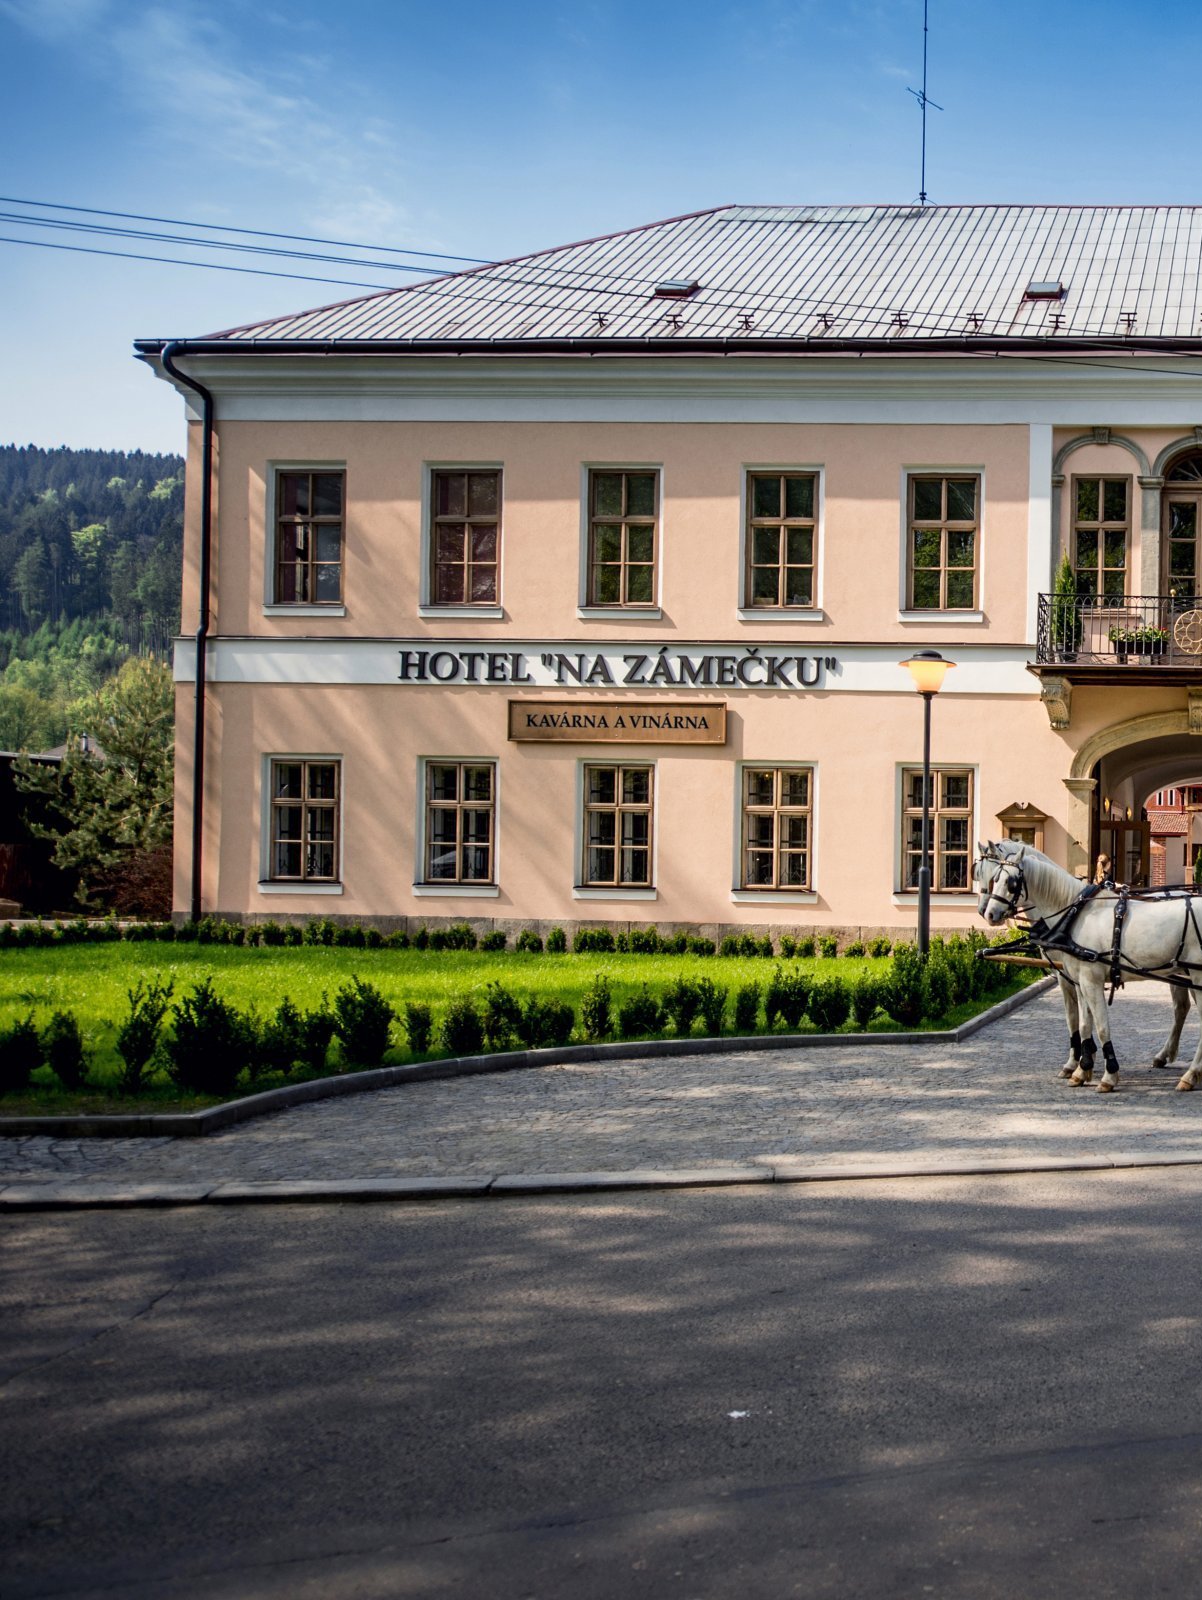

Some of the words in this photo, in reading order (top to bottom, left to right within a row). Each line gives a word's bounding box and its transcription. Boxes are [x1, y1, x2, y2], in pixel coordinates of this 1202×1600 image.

[398, 651, 531, 682] HOTEL
[541, 653, 614, 683] "NA
[623, 646, 836, 686] ZÁMEČKU"
[526, 712, 609, 729] KAVÁRNA
[614, 715, 626, 729] A
[629, 712, 709, 729] VINÁRNA
